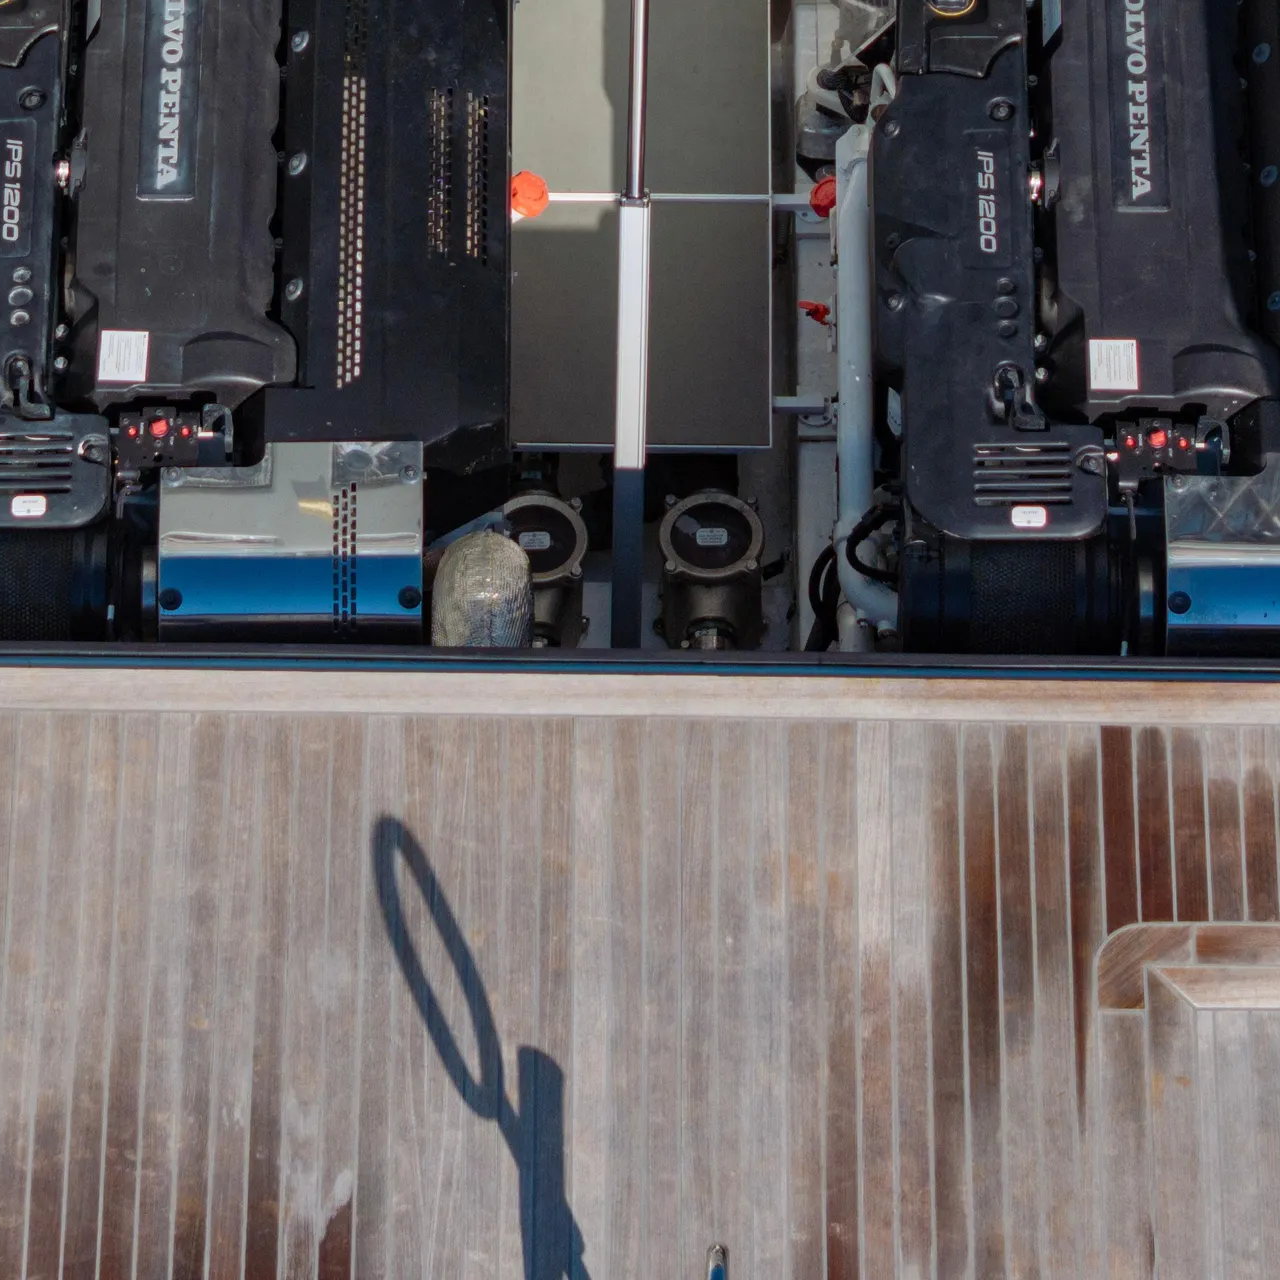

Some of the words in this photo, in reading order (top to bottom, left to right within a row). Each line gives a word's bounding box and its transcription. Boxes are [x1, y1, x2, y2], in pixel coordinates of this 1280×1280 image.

[4, 139, 23, 178] IPS
[155, 67, 182, 190] PENTA
[1127, 80, 1152, 201] PENTA
[977, 150, 995, 190] IPS
[2, 182, 22, 242] 1200
[978, 194, 997, 254] 1200
